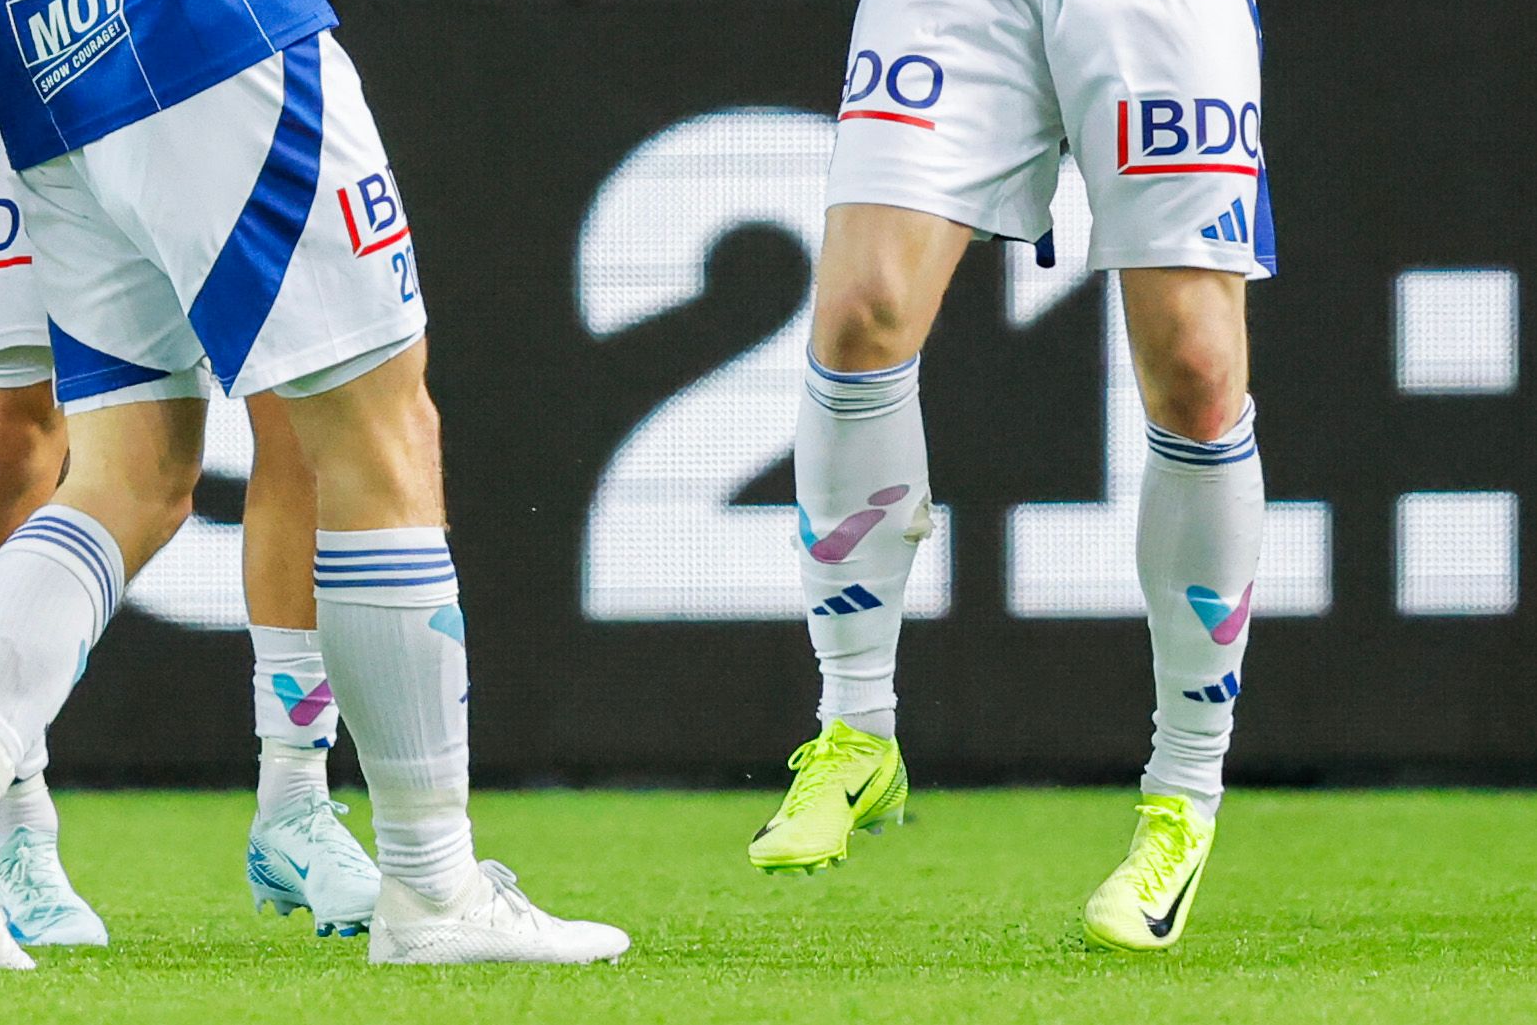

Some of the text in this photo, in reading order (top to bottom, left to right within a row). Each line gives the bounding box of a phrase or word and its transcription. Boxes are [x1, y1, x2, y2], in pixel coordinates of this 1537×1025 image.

[40, 19, 120, 93] SHOW COURAGE!
[847, 49, 944, 109] DO
